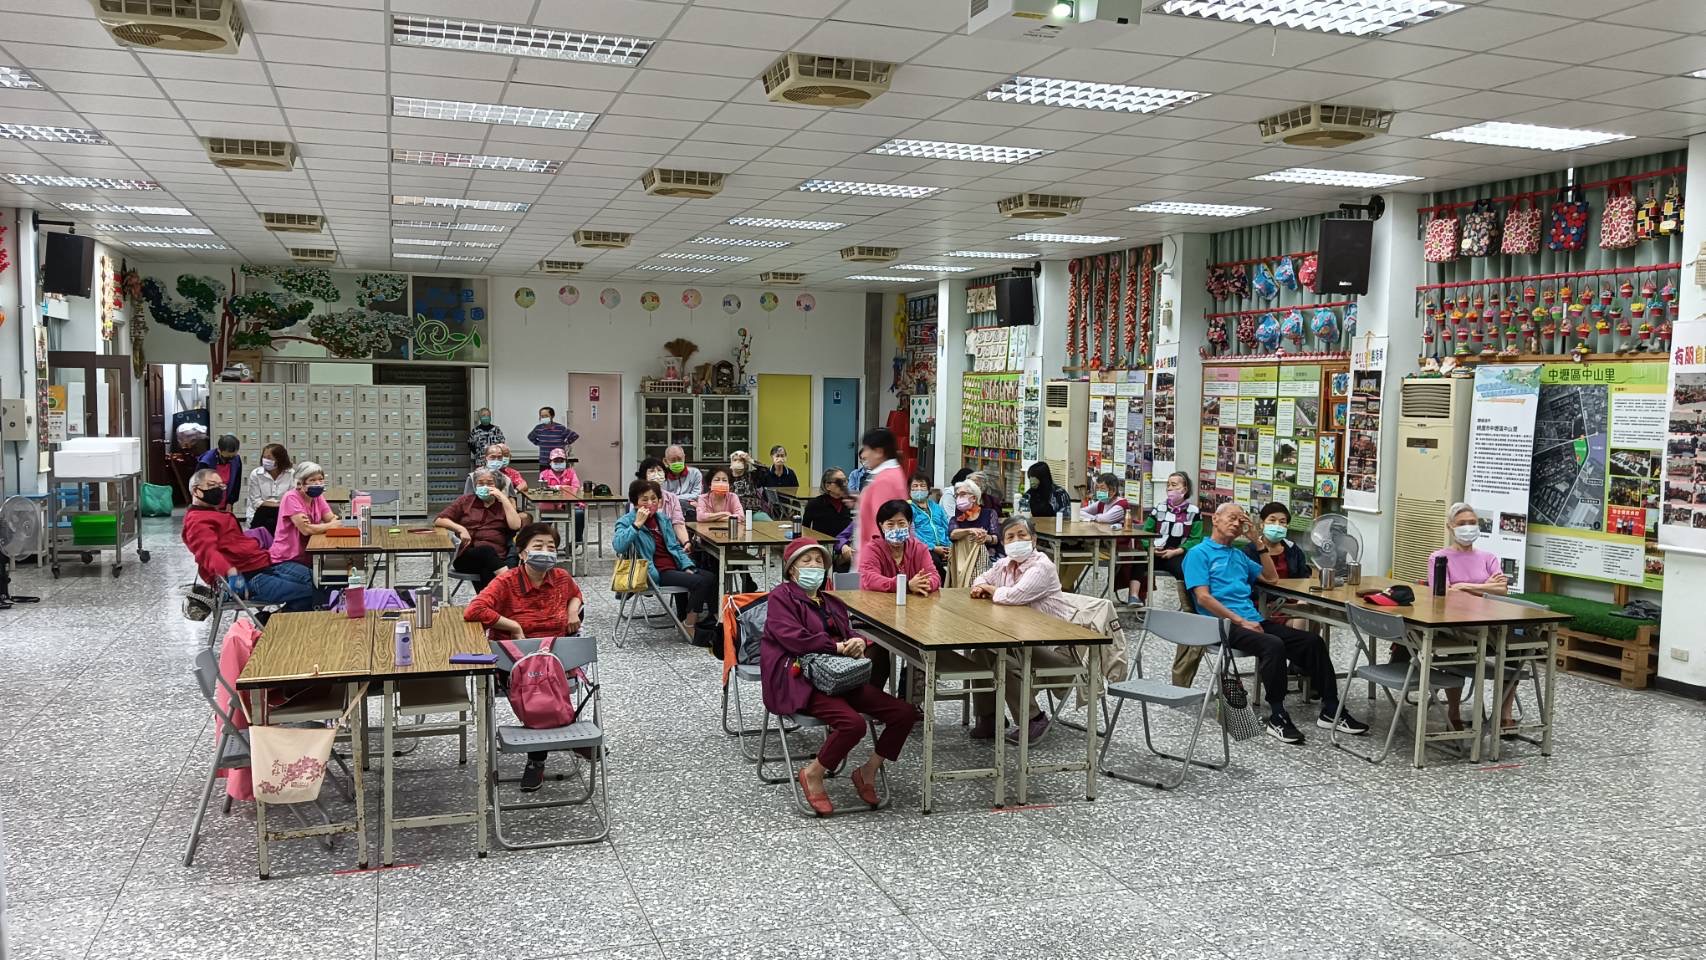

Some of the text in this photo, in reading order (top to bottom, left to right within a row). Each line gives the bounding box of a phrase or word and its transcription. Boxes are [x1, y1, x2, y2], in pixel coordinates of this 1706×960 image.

[1548, 367, 1616, 382] 中壢區中山里
